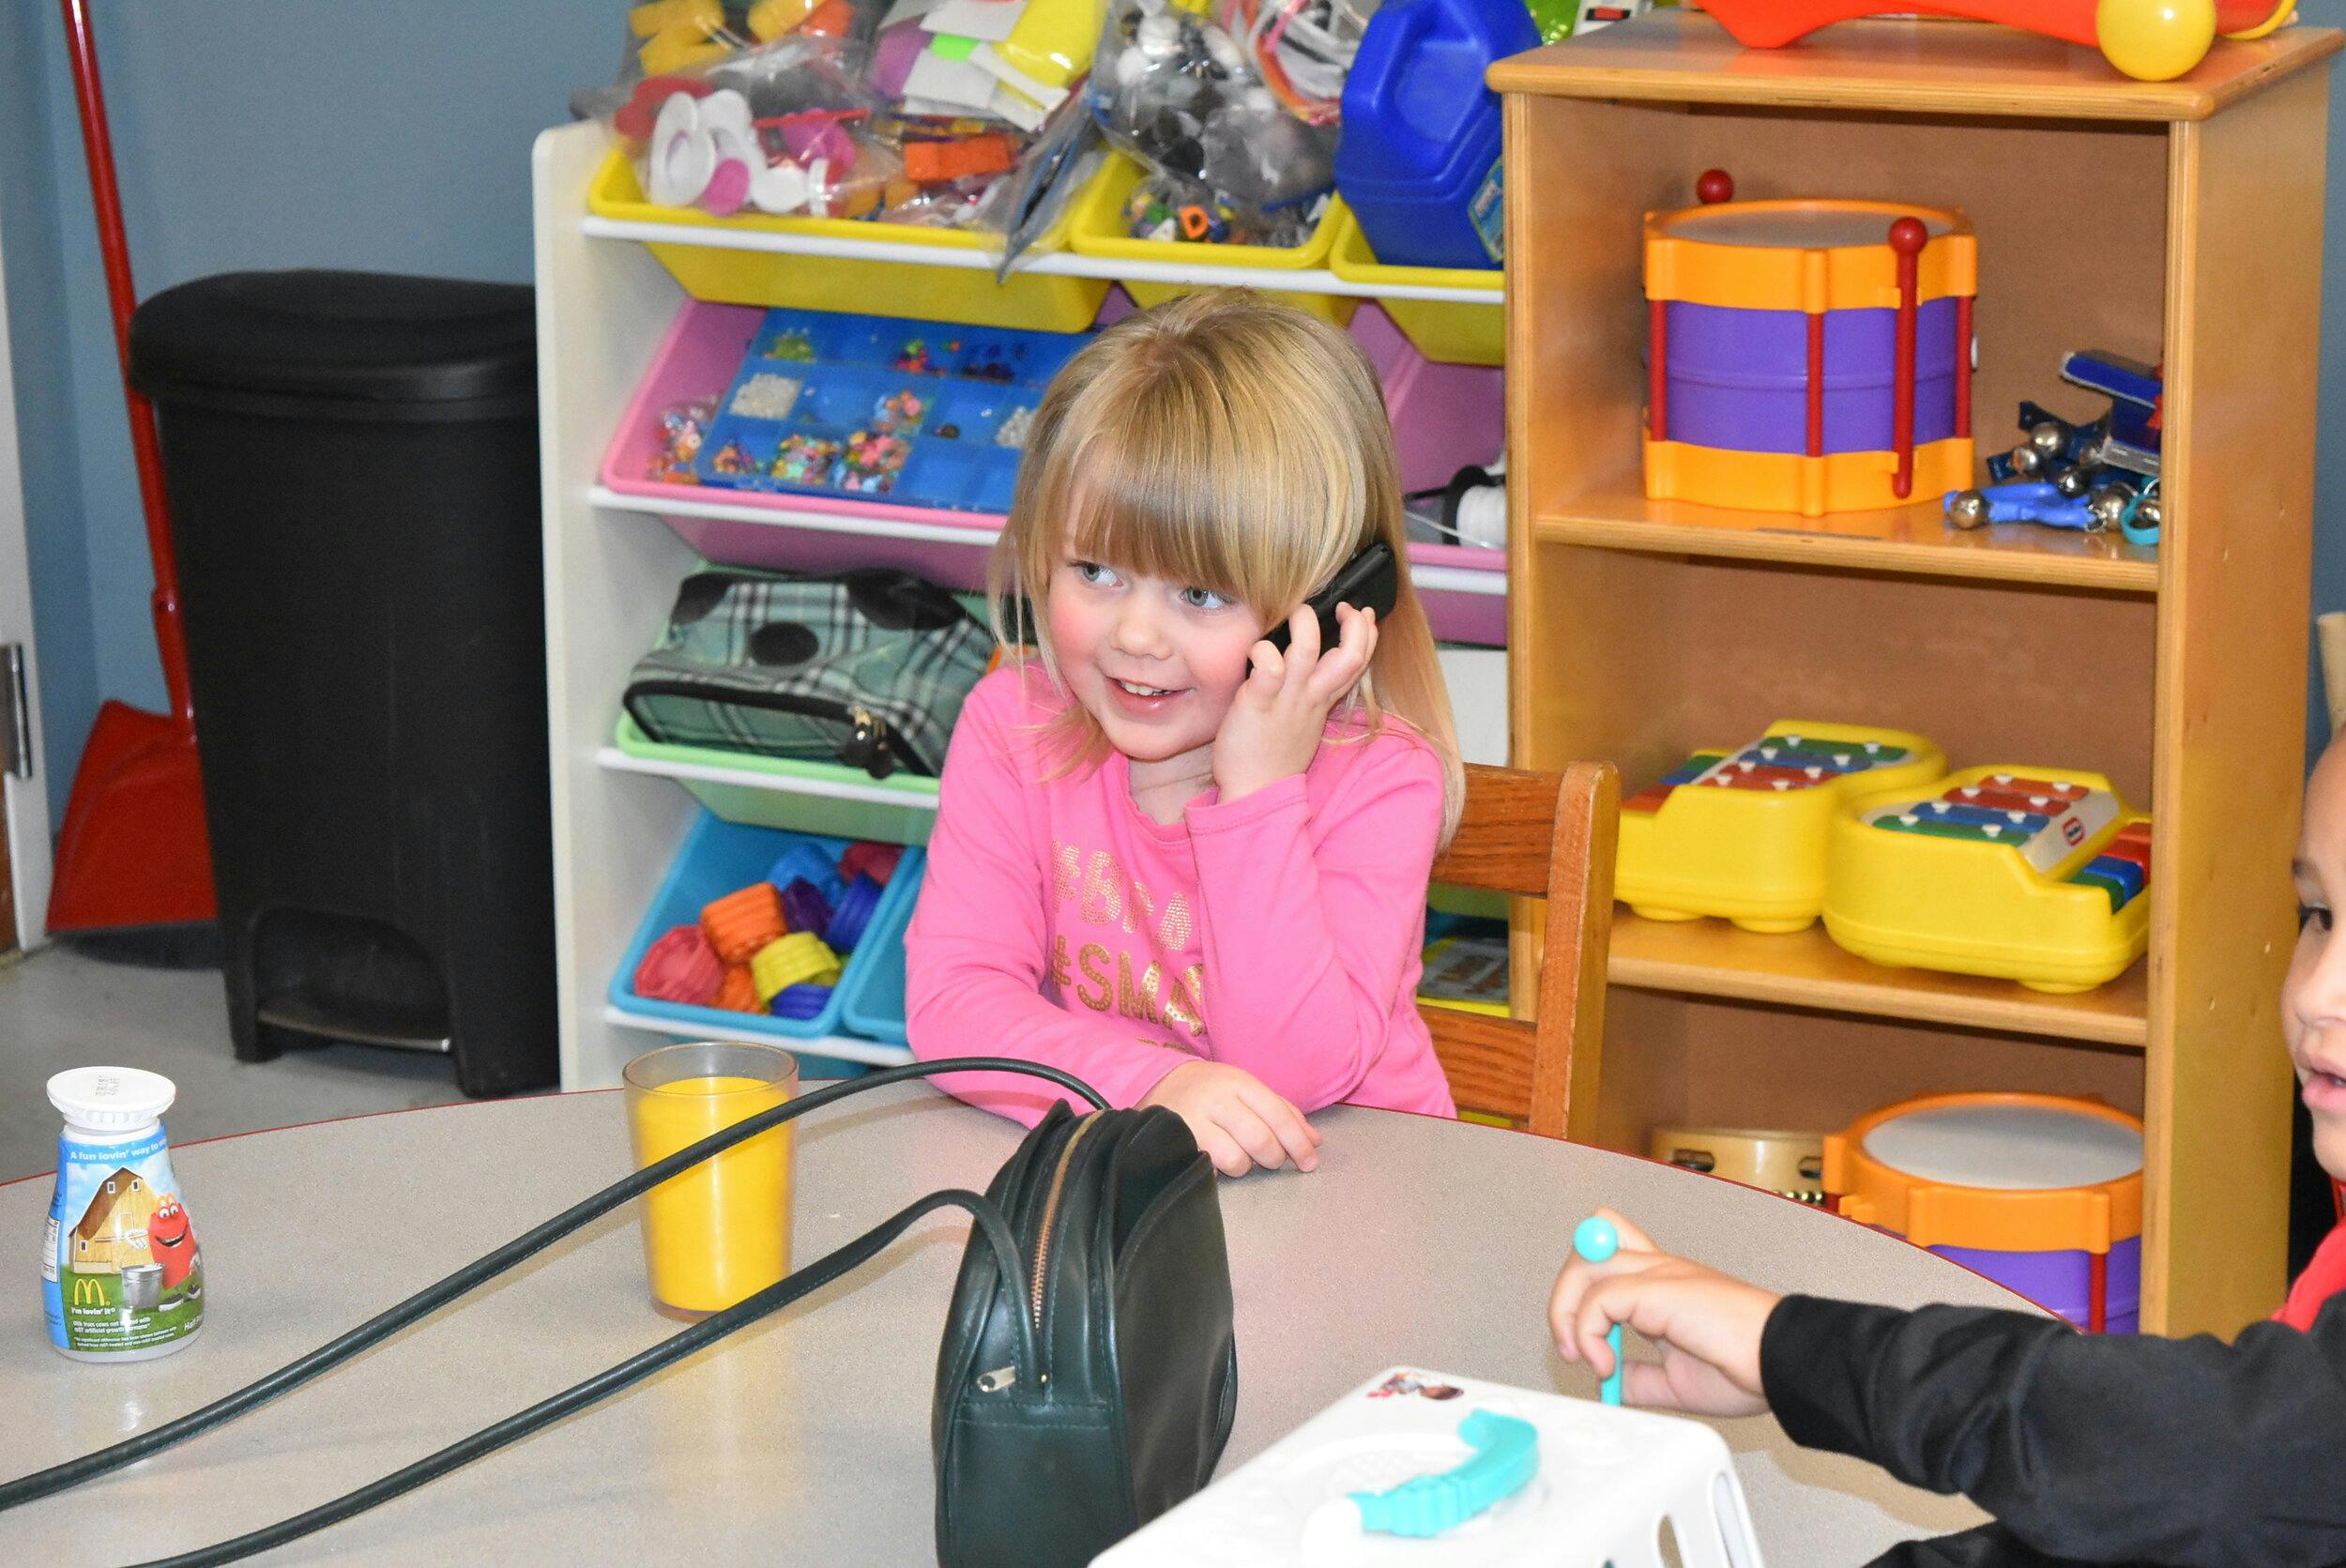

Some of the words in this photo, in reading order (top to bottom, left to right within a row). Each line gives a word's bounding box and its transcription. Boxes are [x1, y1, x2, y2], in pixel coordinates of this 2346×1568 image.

[69, 1151, 78, 1160] A
[79, 1151, 96, 1160] fun
[99, 1149, 129, 1160] lovin'
[131, 1147, 150, 1157] way
